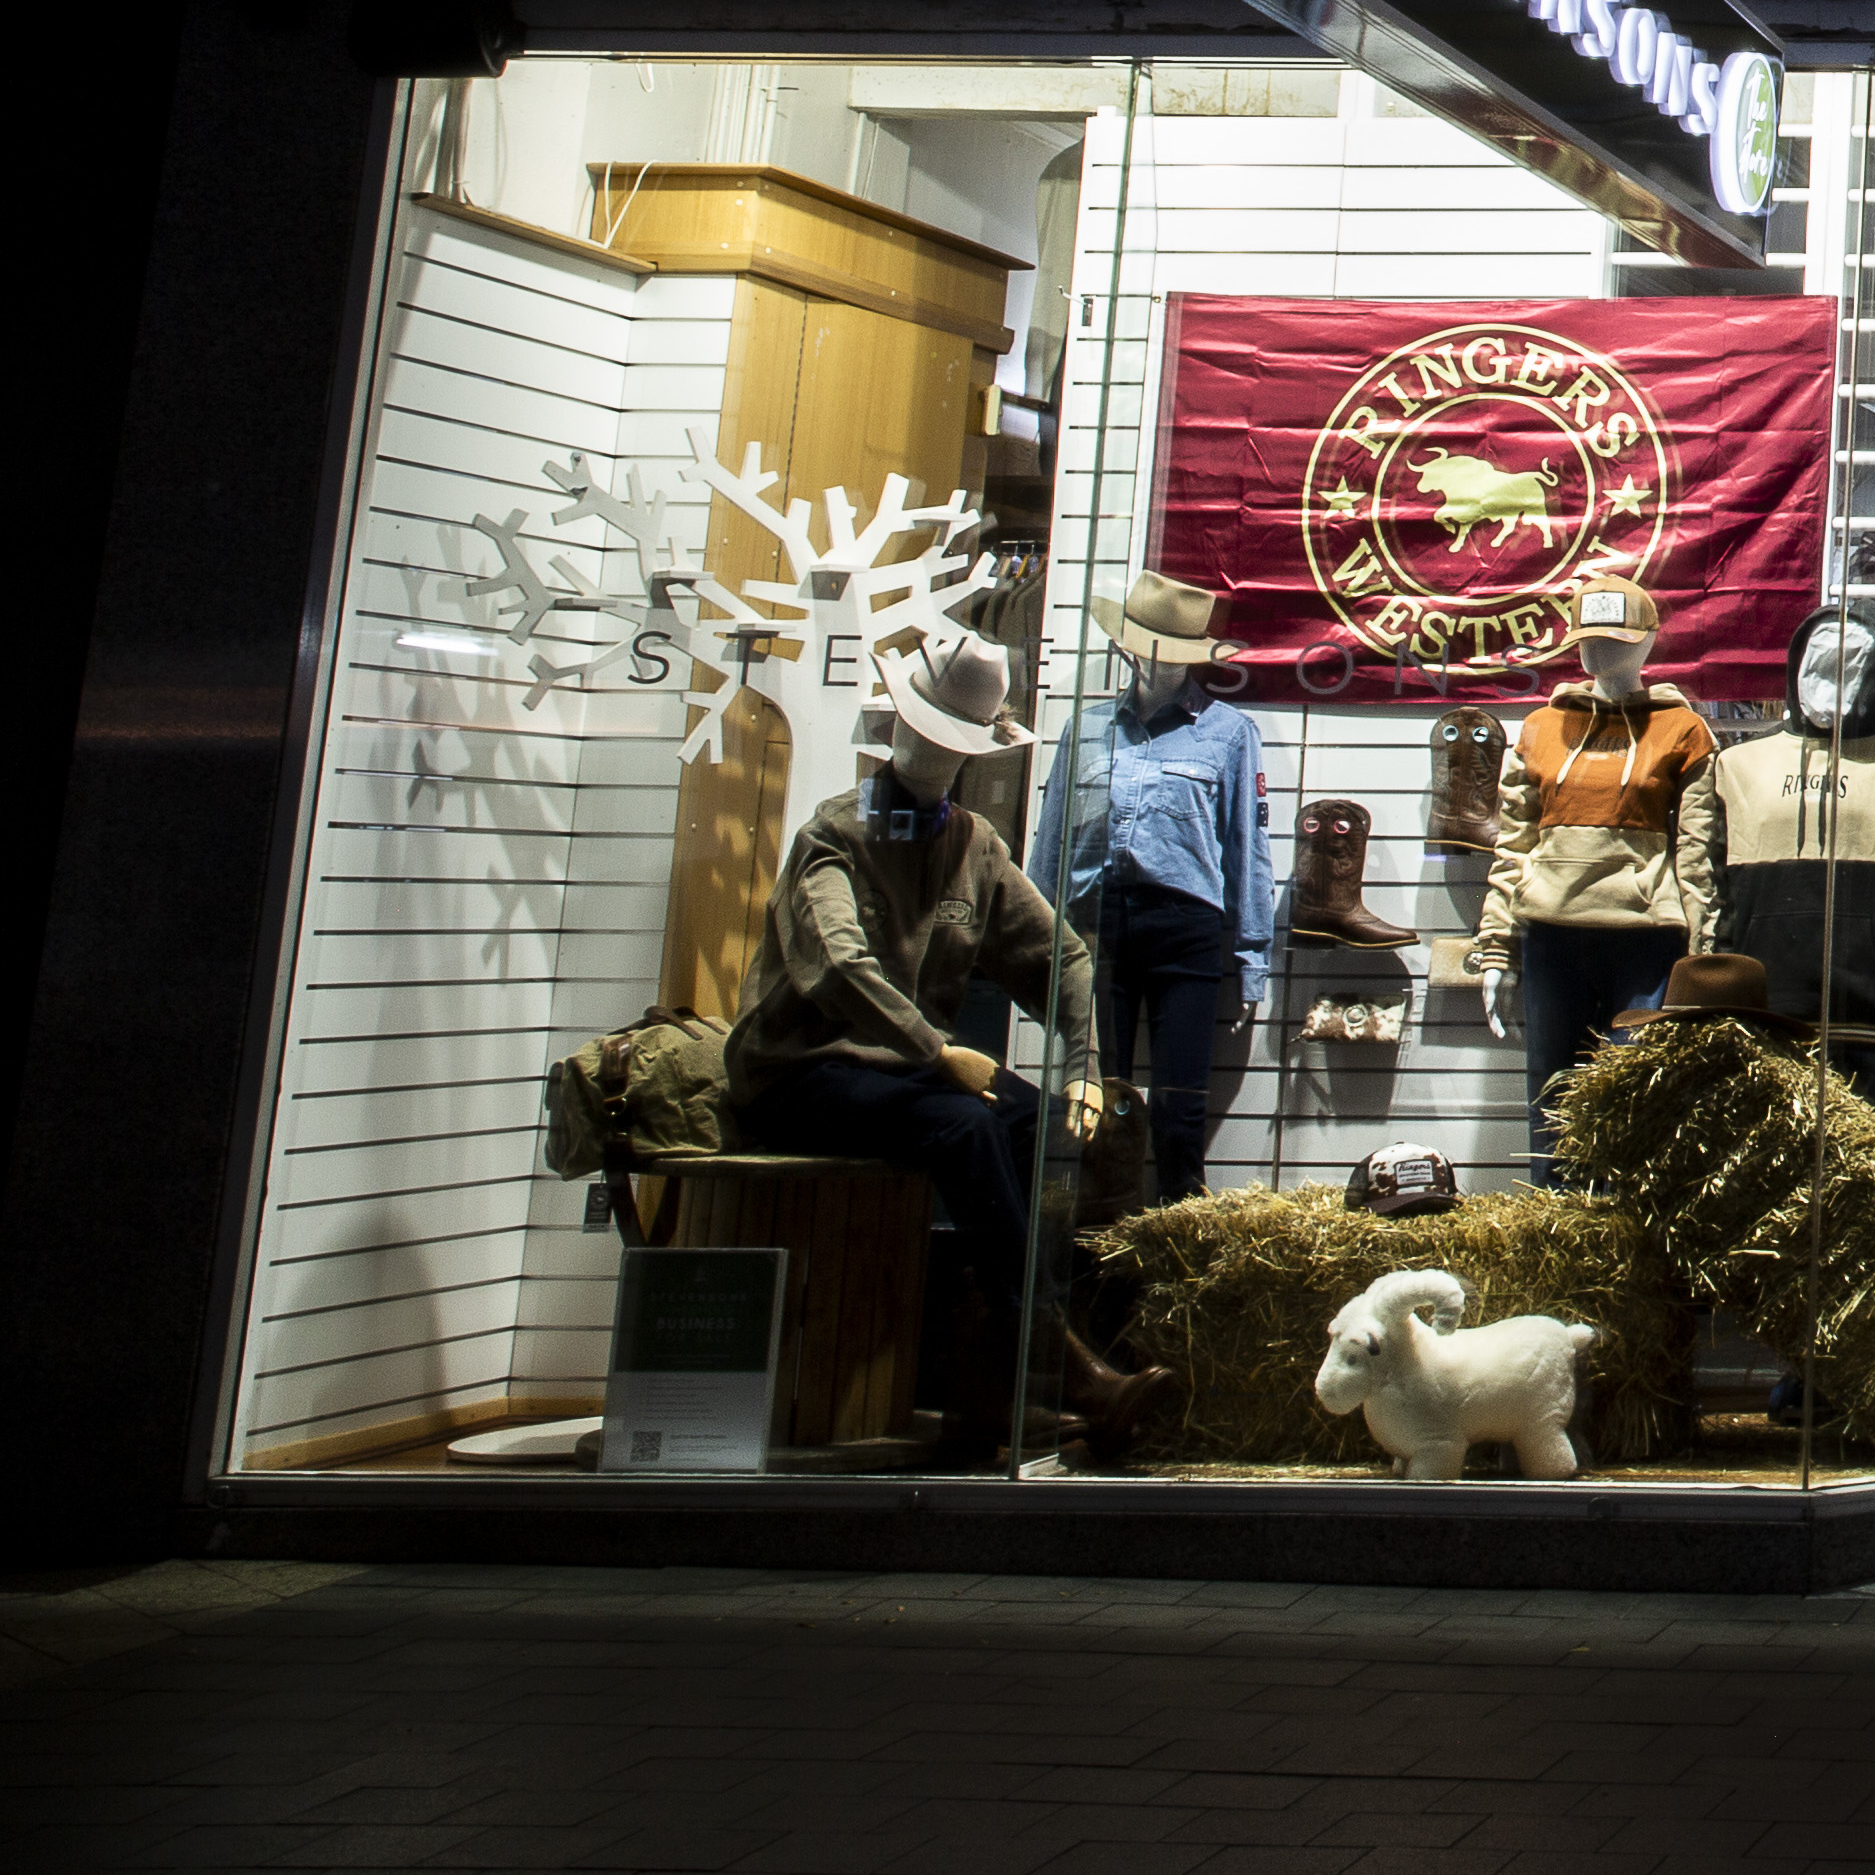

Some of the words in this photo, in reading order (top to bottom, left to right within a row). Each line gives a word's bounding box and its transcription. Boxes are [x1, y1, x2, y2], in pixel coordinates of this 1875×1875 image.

[1745, 66, 1767, 129] The
[1341, 334, 1642, 463] RINGERS
[1331, 534, 1640, 663] WESTERN
[627, 630, 1541, 698] STEVENSONS
[656, 1316, 736, 1330] BUSINESS
